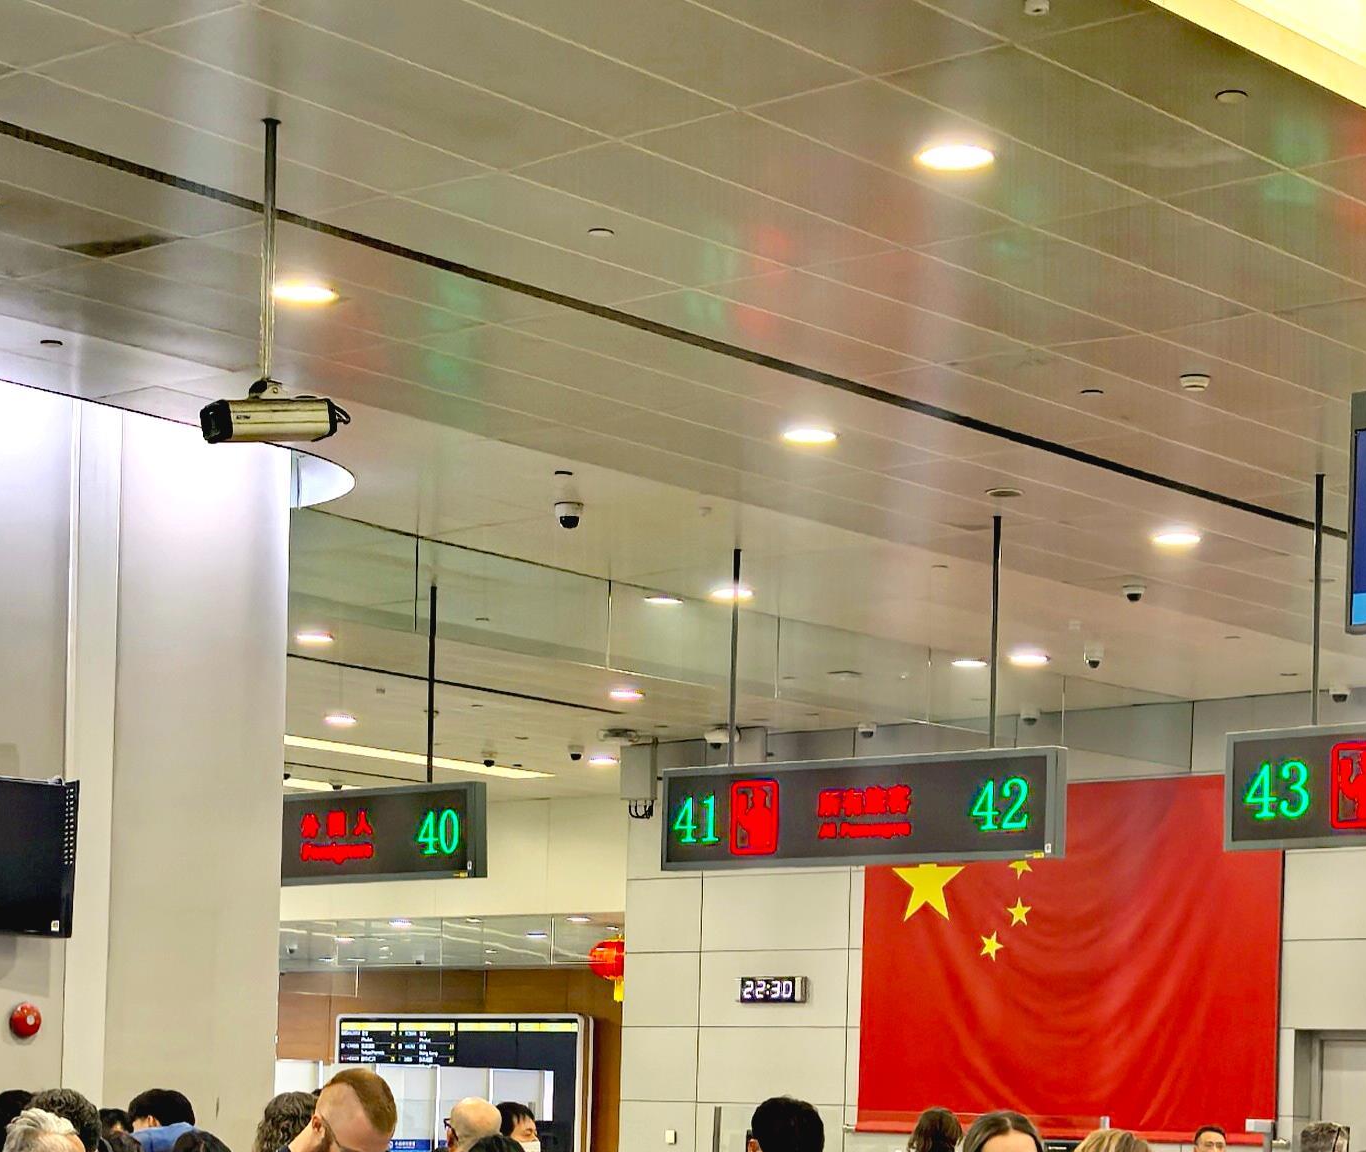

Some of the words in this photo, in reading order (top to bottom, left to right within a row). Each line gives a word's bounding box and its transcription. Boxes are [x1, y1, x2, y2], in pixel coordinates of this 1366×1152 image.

[970, 776, 1031, 832] 42
[1245, 758, 1309, 819] 43
[417, 808, 460, 856] 40
[672, 795, 720, 844] 41
[743, 980, 793, 999] 22:30
